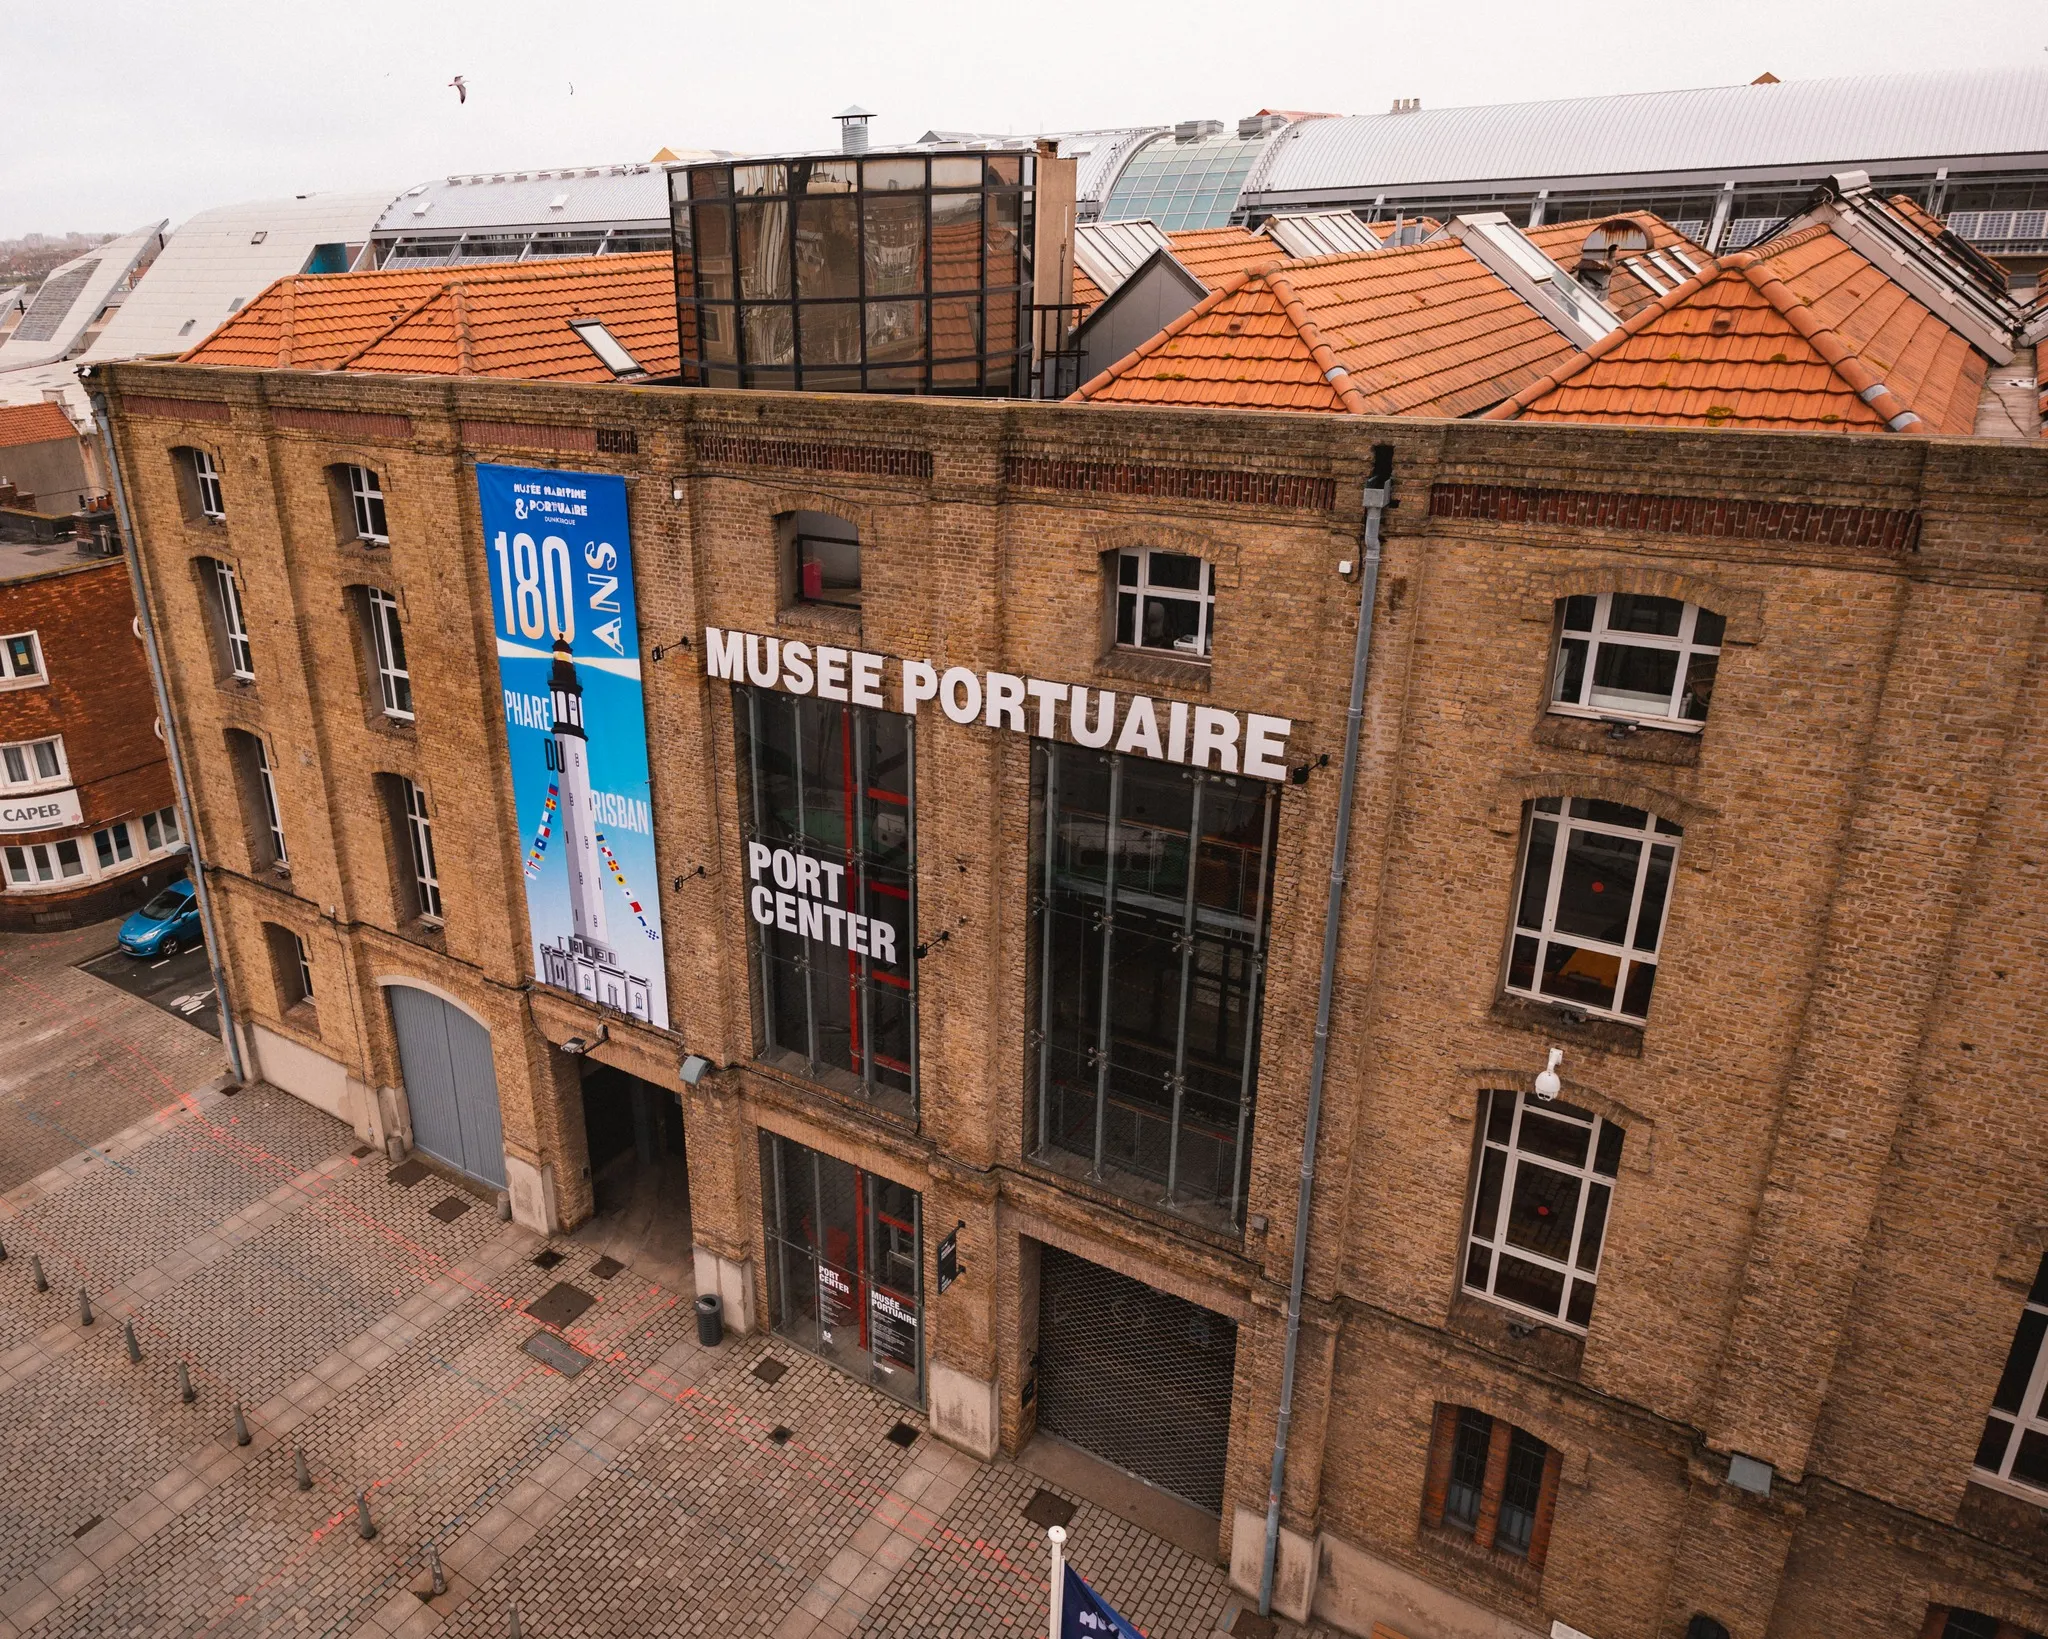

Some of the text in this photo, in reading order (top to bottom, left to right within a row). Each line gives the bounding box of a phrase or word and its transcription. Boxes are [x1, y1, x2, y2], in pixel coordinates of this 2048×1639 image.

[515, 498, 528, 519] &
[544, 486, 587, 499] MARITIME
[495, 531, 575, 644] 180
[584, 541, 624, 656] ANS
[504, 689, 552, 732] PHARE
[706, 626, 1292, 781] MUSEE PORTUAIRE
[544, 738, 565, 773] DU
[3, 803, 61, 822] CAPEB
[590, 789, 649, 835] RISBAN
[748, 841, 844, 903] PORT
[751, 885, 897, 964] CENTER
[819, 1265, 839, 1281] PORT
[819, 1273, 850, 1294] CENTER
[871, 1290, 900, 1311] MUSÉE
[871, 1298, 918, 1327] PORTUAIRE
